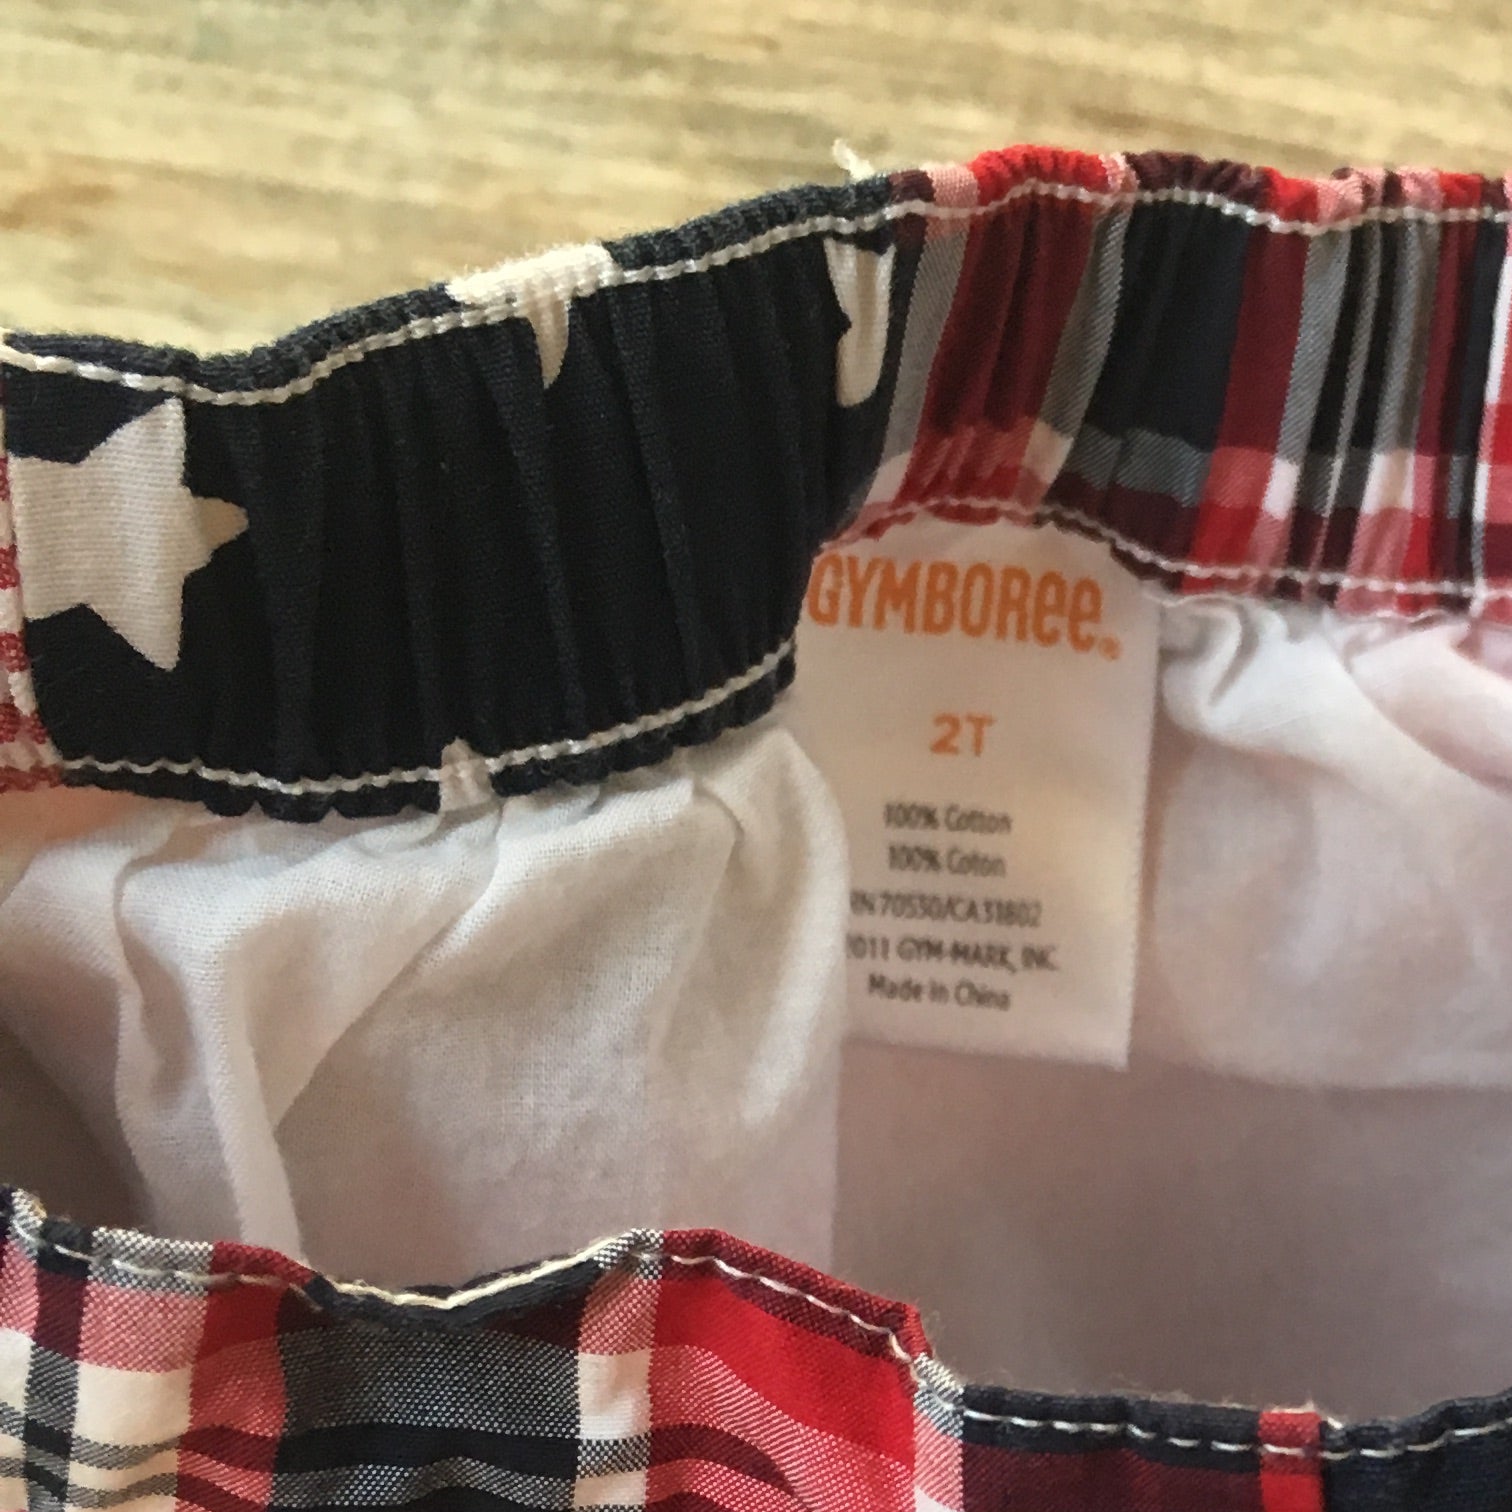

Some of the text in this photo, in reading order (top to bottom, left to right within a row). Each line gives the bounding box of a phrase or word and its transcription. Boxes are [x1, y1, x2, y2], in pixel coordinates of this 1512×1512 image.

[930, 712, 997, 757] 2T
[884, 803, 1012, 835] 100% Cotton
[888, 845, 941, 873] 100%
[867, 972, 1011, 1012] Made in China
